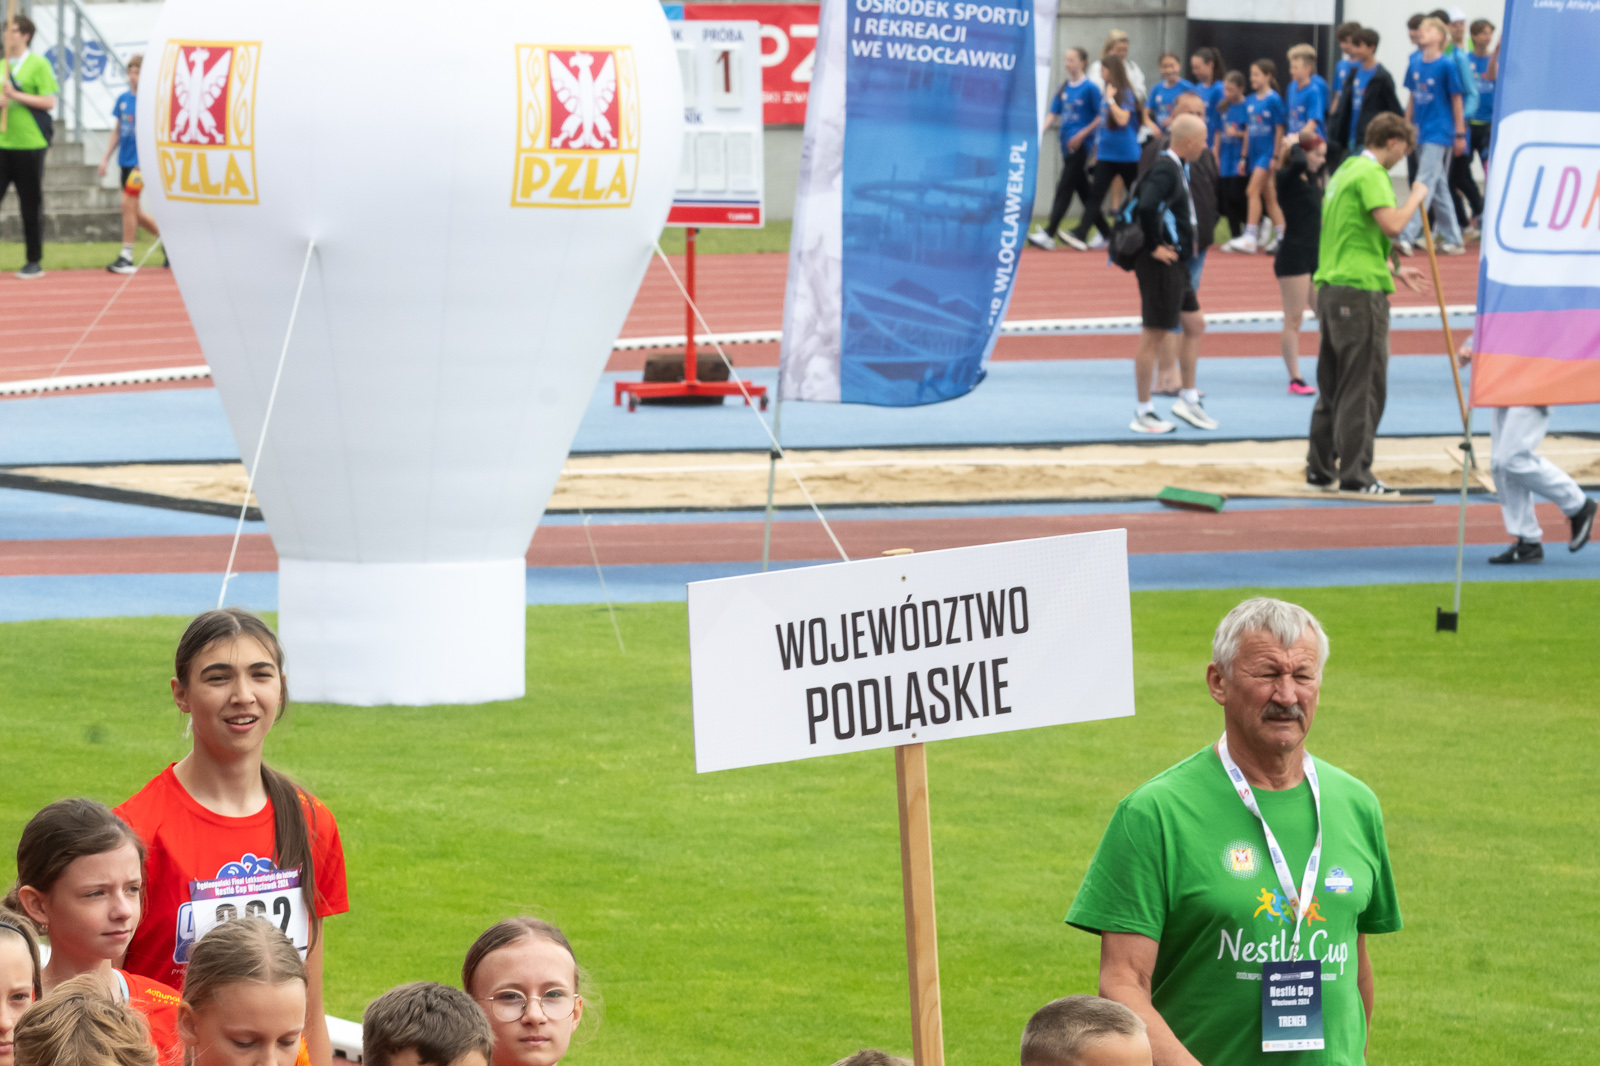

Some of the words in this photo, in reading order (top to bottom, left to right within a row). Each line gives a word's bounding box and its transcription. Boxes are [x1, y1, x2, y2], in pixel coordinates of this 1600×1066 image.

[854, 17, 861, 34] I
[865, 18, 968, 43] REKREACJI
[953, 3, 1030, 27] SPORTU
[716, 50, 731, 93] 1
[852, 39, 883, 58] WE
[886, 41, 1017, 71] WŁOCŁAWKU
[160, 149, 250, 196] PZLA
[520, 156, 627, 200] PZLA
[775, 586, 1030, 671] WOJEWÓDZTWO
[805, 657, 1012, 744] PODLASKIE
[1309, 929, 1348, 975] Cup
[1270, 986, 1296, 997] Nestlé
[1298, 985, 1314, 998] Cup
[1278, 1015, 1307, 1027] TRENER
